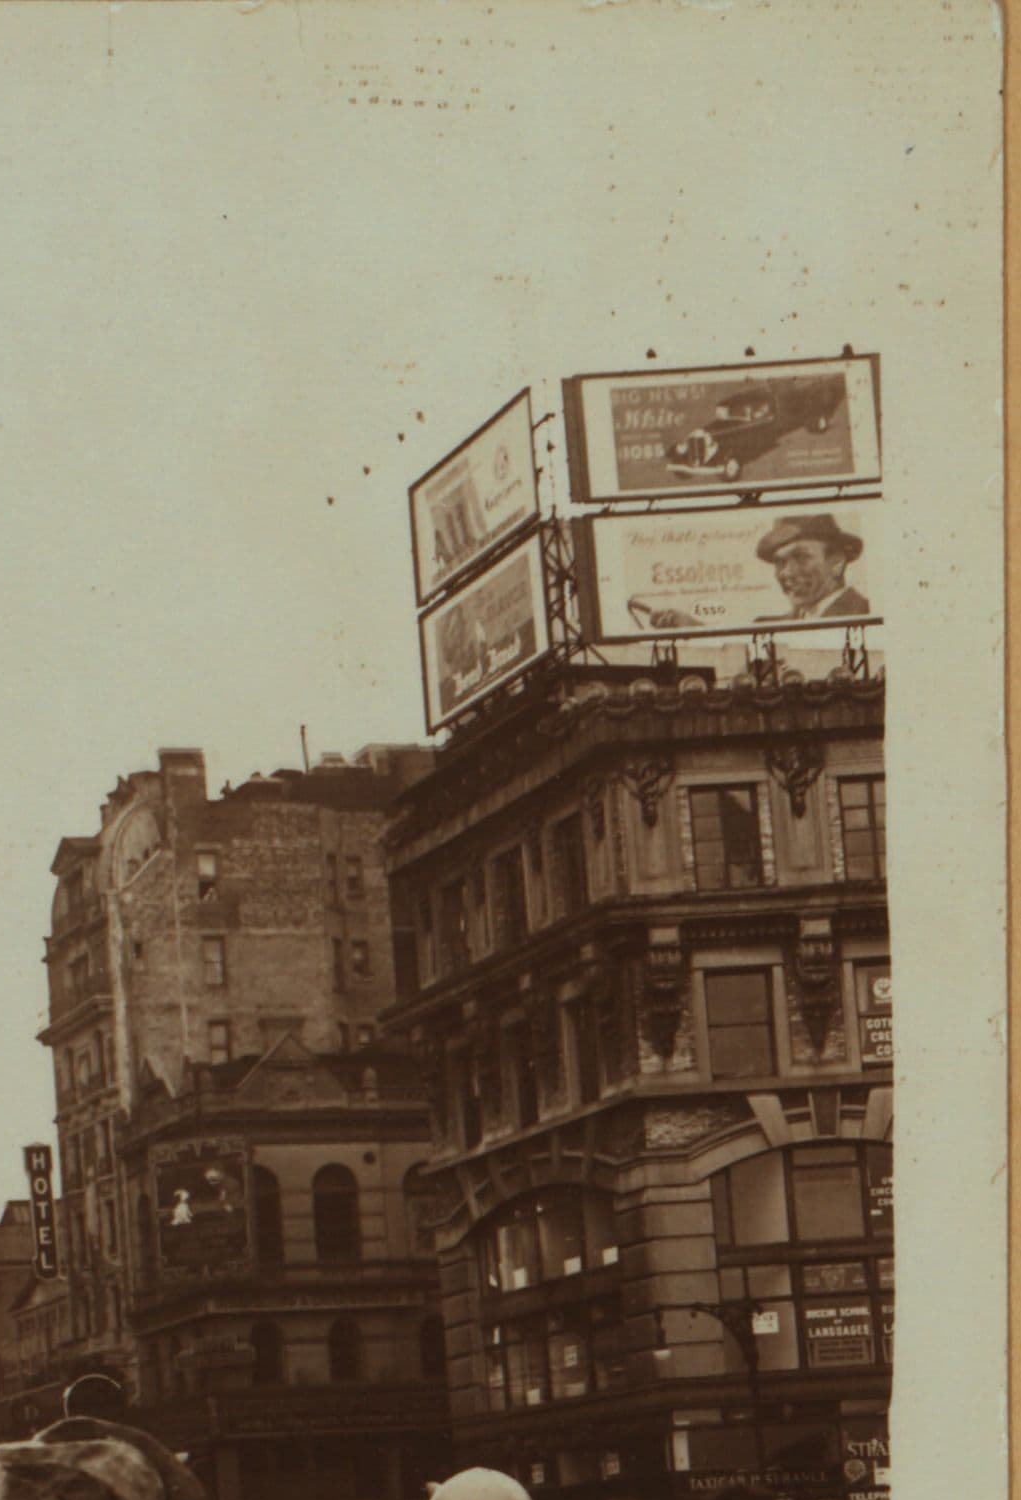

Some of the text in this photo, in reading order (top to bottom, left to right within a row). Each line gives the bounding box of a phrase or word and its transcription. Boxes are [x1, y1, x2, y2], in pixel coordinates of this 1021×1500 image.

[651, 560, 744, 586] Essolene
[694, 603, 726, 616] Esso
[31, 1152, 54, 1270] HOTEL
[808, 1323, 870, 1339] LANGUAGES
